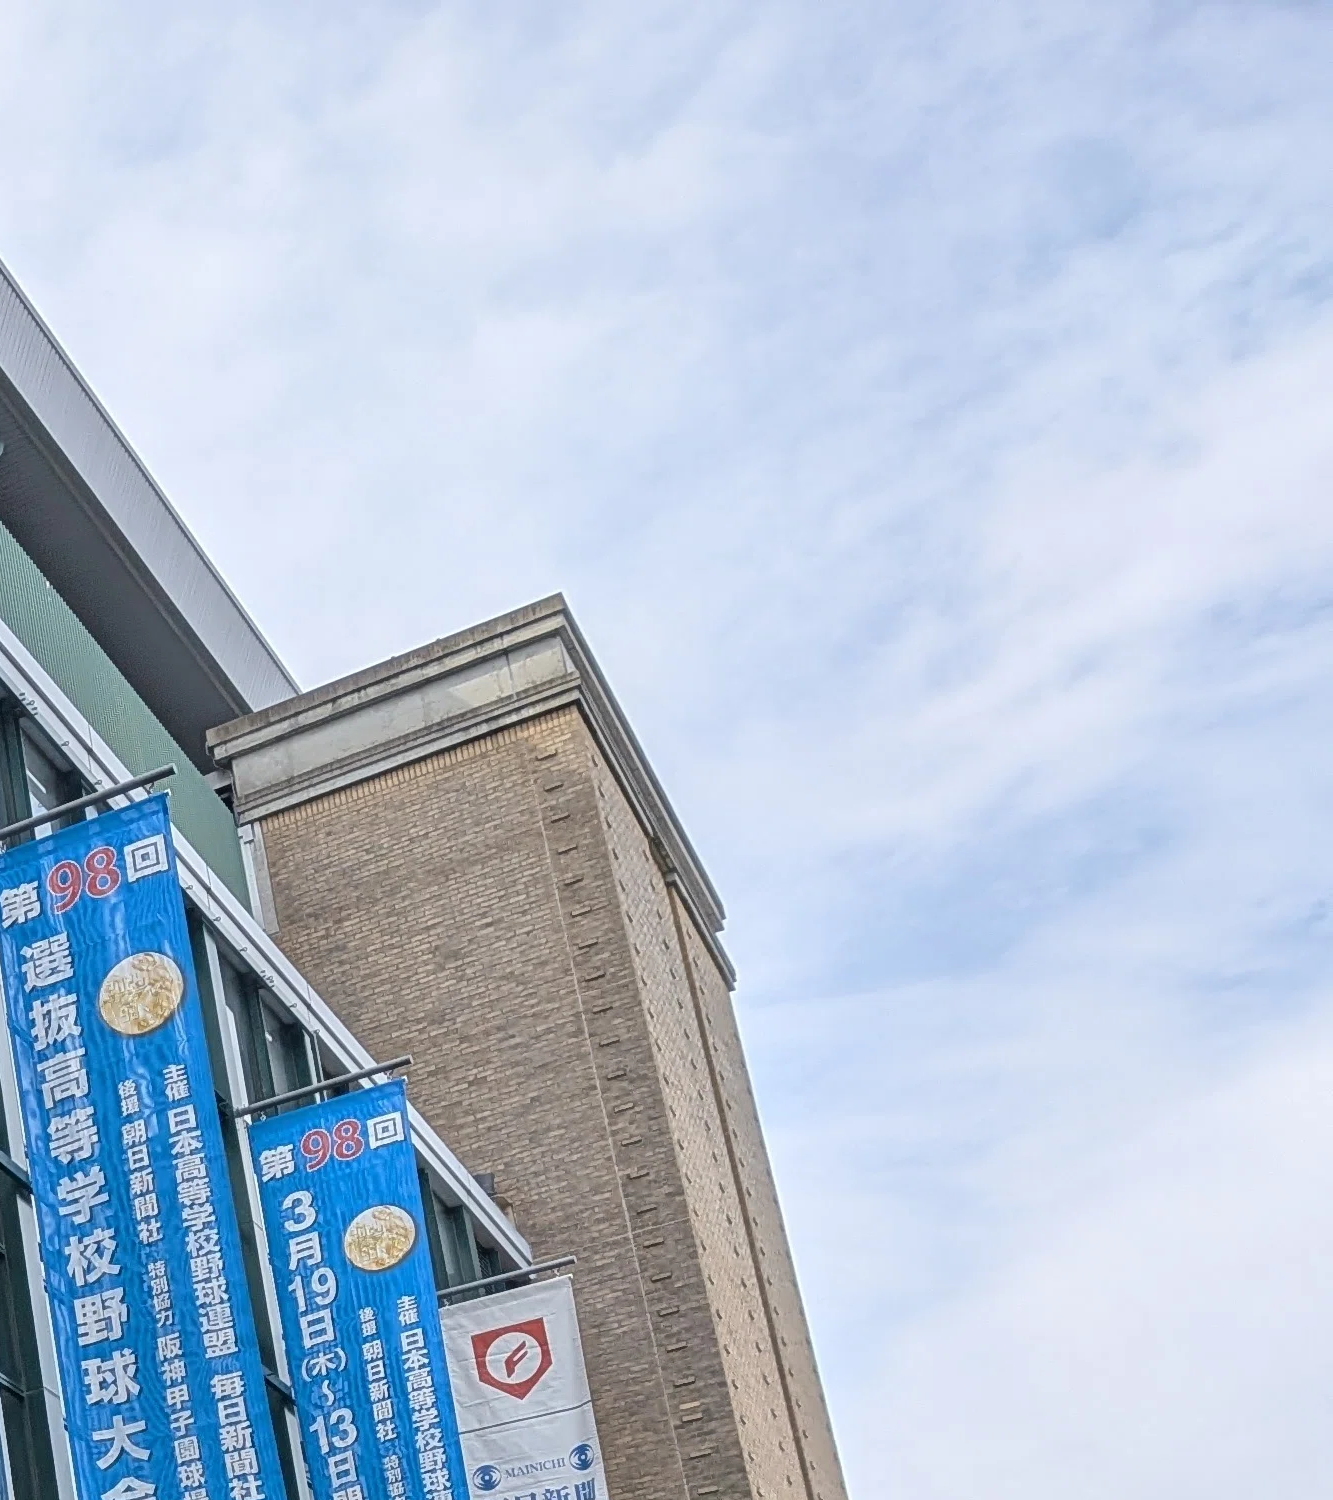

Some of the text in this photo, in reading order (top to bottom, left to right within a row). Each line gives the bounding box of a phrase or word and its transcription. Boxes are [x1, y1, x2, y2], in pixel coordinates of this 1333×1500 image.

[162, 1062, 191, 1103] 主催
[121, 1119, 164, 1246] 朝日新聞社
[258, 1110, 405, 1183] 第98回
[166, 1103, 240, 1360] 日本高等学校野球連盟
[361, 1338, 398, 1443] 朝日新聞社
[505, 1456, 567, 1479] MAINICHI
